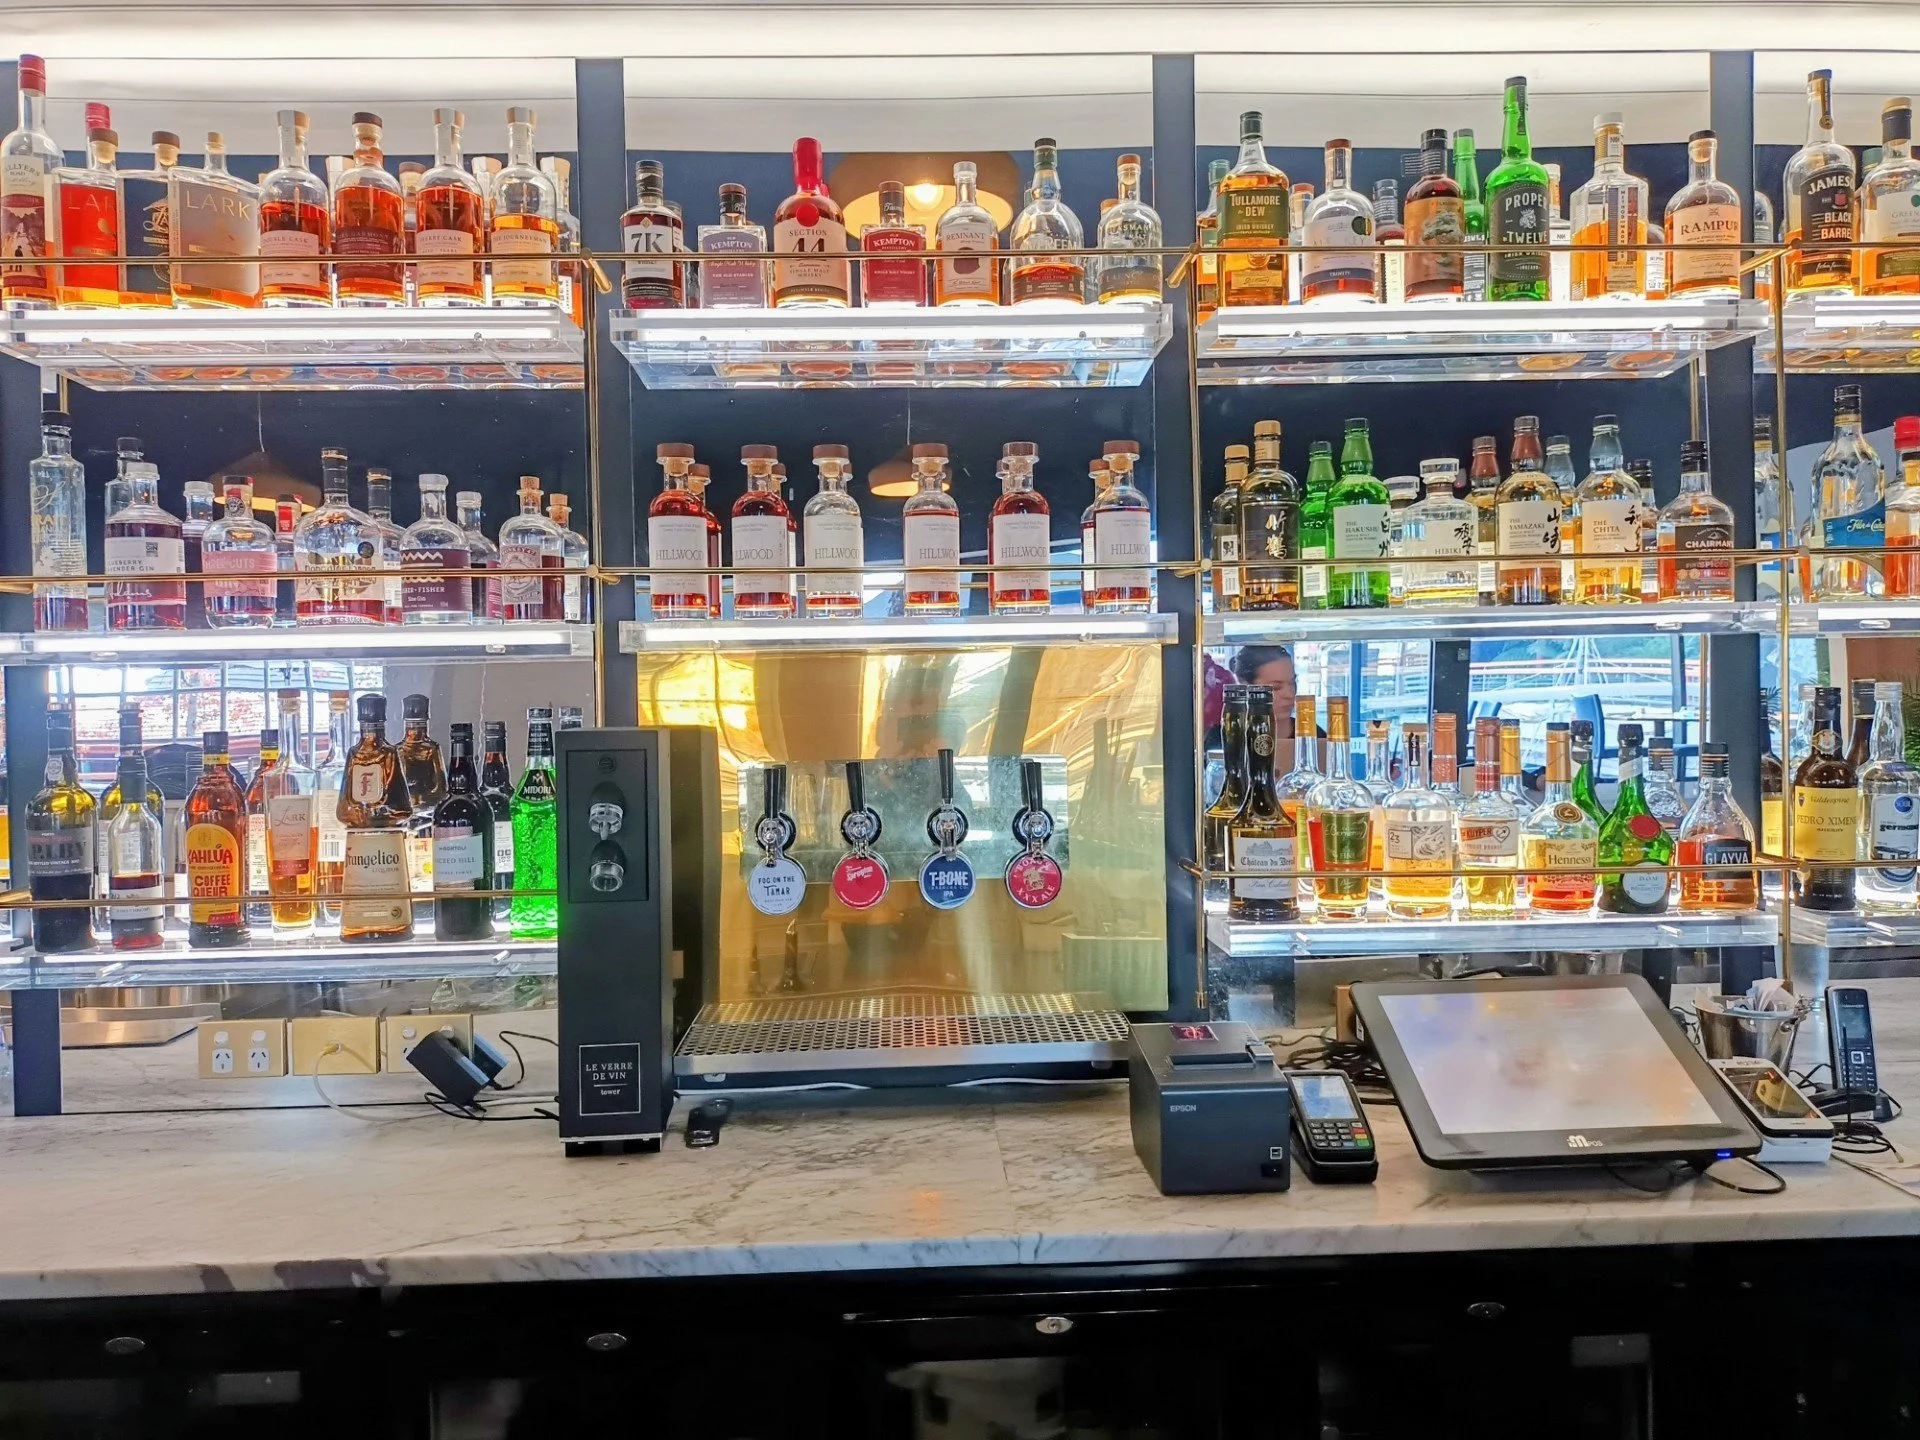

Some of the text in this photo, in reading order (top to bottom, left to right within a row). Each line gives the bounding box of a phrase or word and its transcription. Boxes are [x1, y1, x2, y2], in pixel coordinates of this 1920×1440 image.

[1229, 193, 1280, 206] TULLAMORE
[186, 190, 250, 222] LARK
[1245, 206, 1266, 217] DEW
[789, 228, 827, 237] SECTION
[1681, 220, 1738, 236] RAMPUR
[1821, 227, 1852, 240] BARRE
[503, 233, 547, 243] JOURNEYMAN
[631, 232, 664, 253] 7K
[873, 238, 916, 247] KEMPTON
[946, 232, 985, 241] REMNANT
[1507, 230, 1548, 244] TWELVE
[711, 240, 753, 249] KEMPTON
[1846, 519, 1866, 532] Flor
[919, 547, 957, 559] HILLWO
[1001, 546, 1047, 558] HILLWOOD
[1111, 544, 1150, 555] HILLWO
[1434, 547, 1462, 555] HIBIKI
[229, 558, 255, 568] CUTS
[523, 785, 551, 795] MIDORI
[1796, 815, 1825, 825] PEDRO
[1390, 832, 1400, 844] 23
[1466, 826, 1492, 838] KUYPER
[1705, 852, 1749, 865] GLAYVA
[195, 874, 231, 887] COFFEE
[928, 871, 969, 886] T-BONE
[193, 885, 228, 897] QUEUR
[764, 885, 791, 897] TAMAR
[1041, 885, 1056, 900] ALE
[586, 1062, 633, 1072] LE VERRE
[592, 1071, 626, 1081] DE VIN
[600, 1088, 621, 1096] tower
[1170, 1104, 1197, 1112] EPSON
